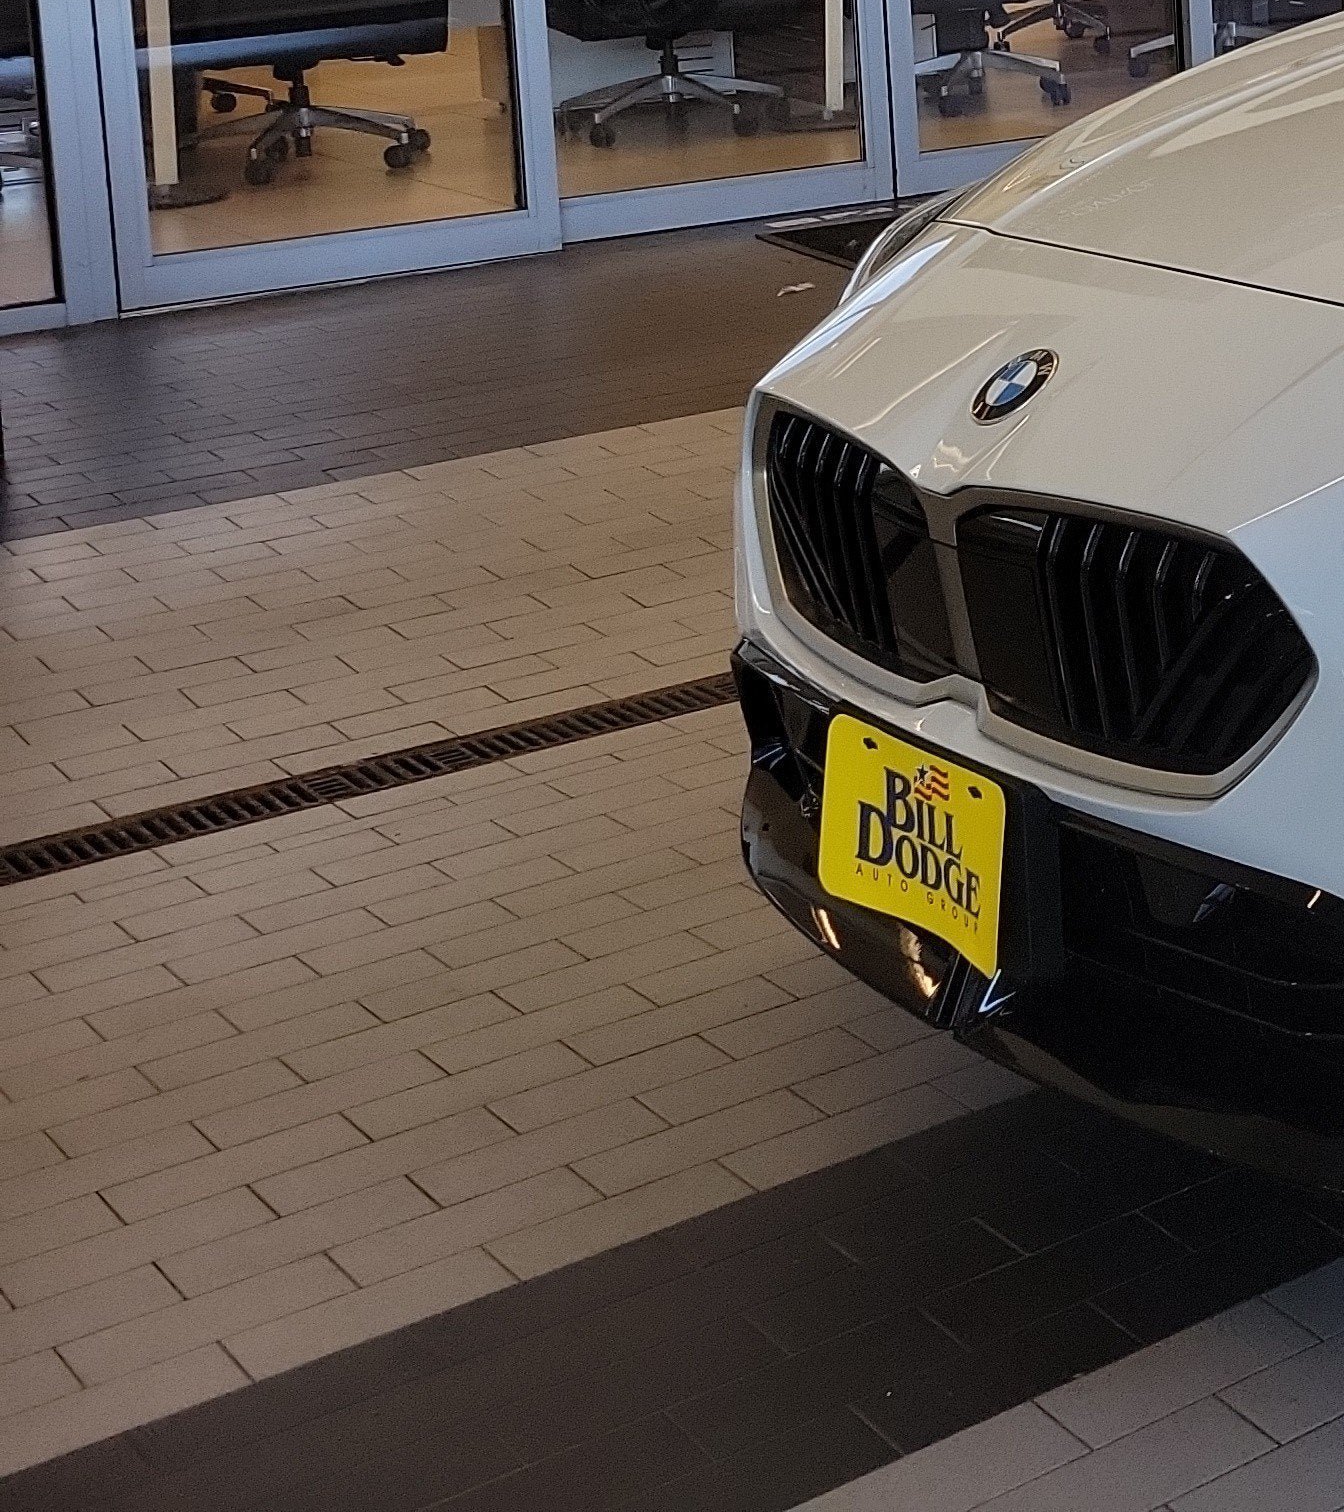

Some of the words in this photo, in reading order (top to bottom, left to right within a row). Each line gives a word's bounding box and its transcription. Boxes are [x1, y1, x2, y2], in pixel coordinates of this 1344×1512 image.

[855, 799, 982, 919] DODGE
[882, 765, 963, 862] BILL
[855, 862, 909, 893] AUTO
[926, 890, 980, 936] GROUP
